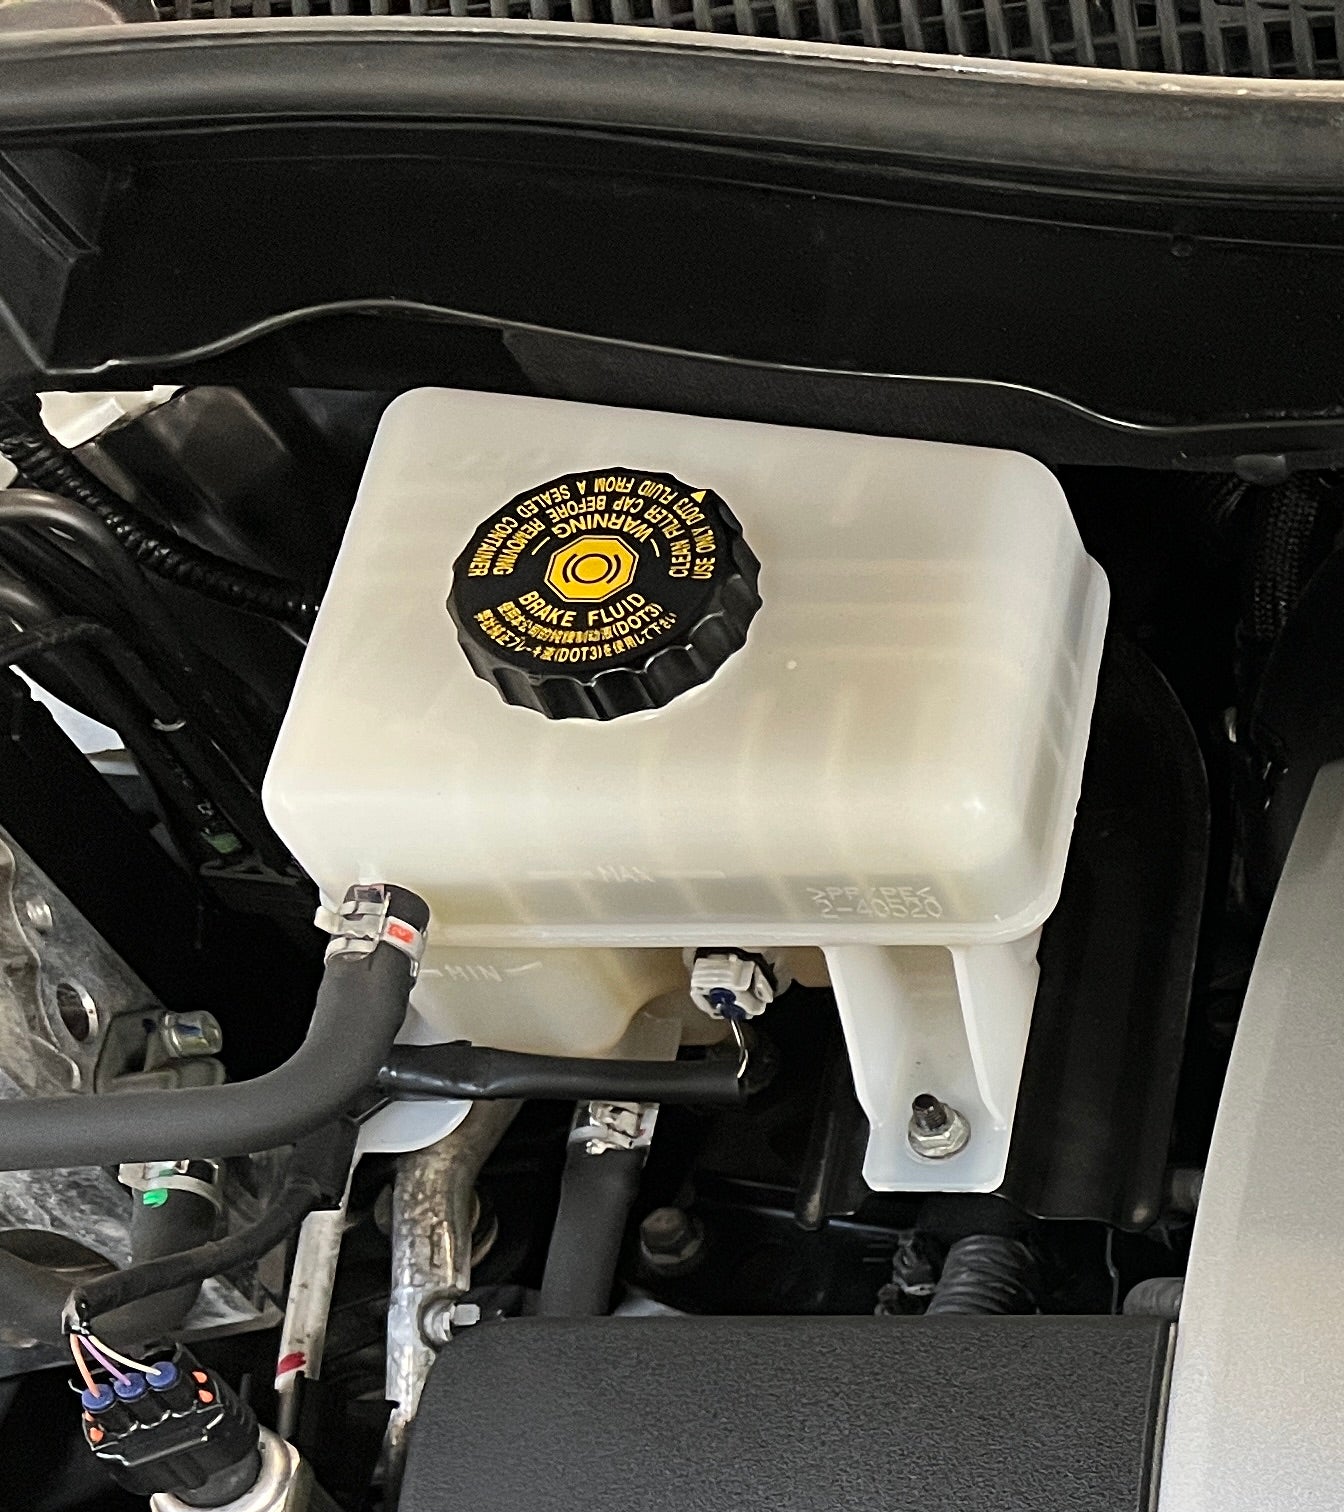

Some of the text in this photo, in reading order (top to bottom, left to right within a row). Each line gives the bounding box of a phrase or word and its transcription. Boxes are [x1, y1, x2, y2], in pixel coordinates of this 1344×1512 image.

[468, 477, 716, 579] USE ONLY DOT3 FLUID FROM A SEALED CONTAINER
[492, 495, 692, 578] CLEAN FILLER CAP BEFORE REMOVING
[551, 513, 654, 543] WARNING
[518, 590, 645, 627] BRAKE FLUID
